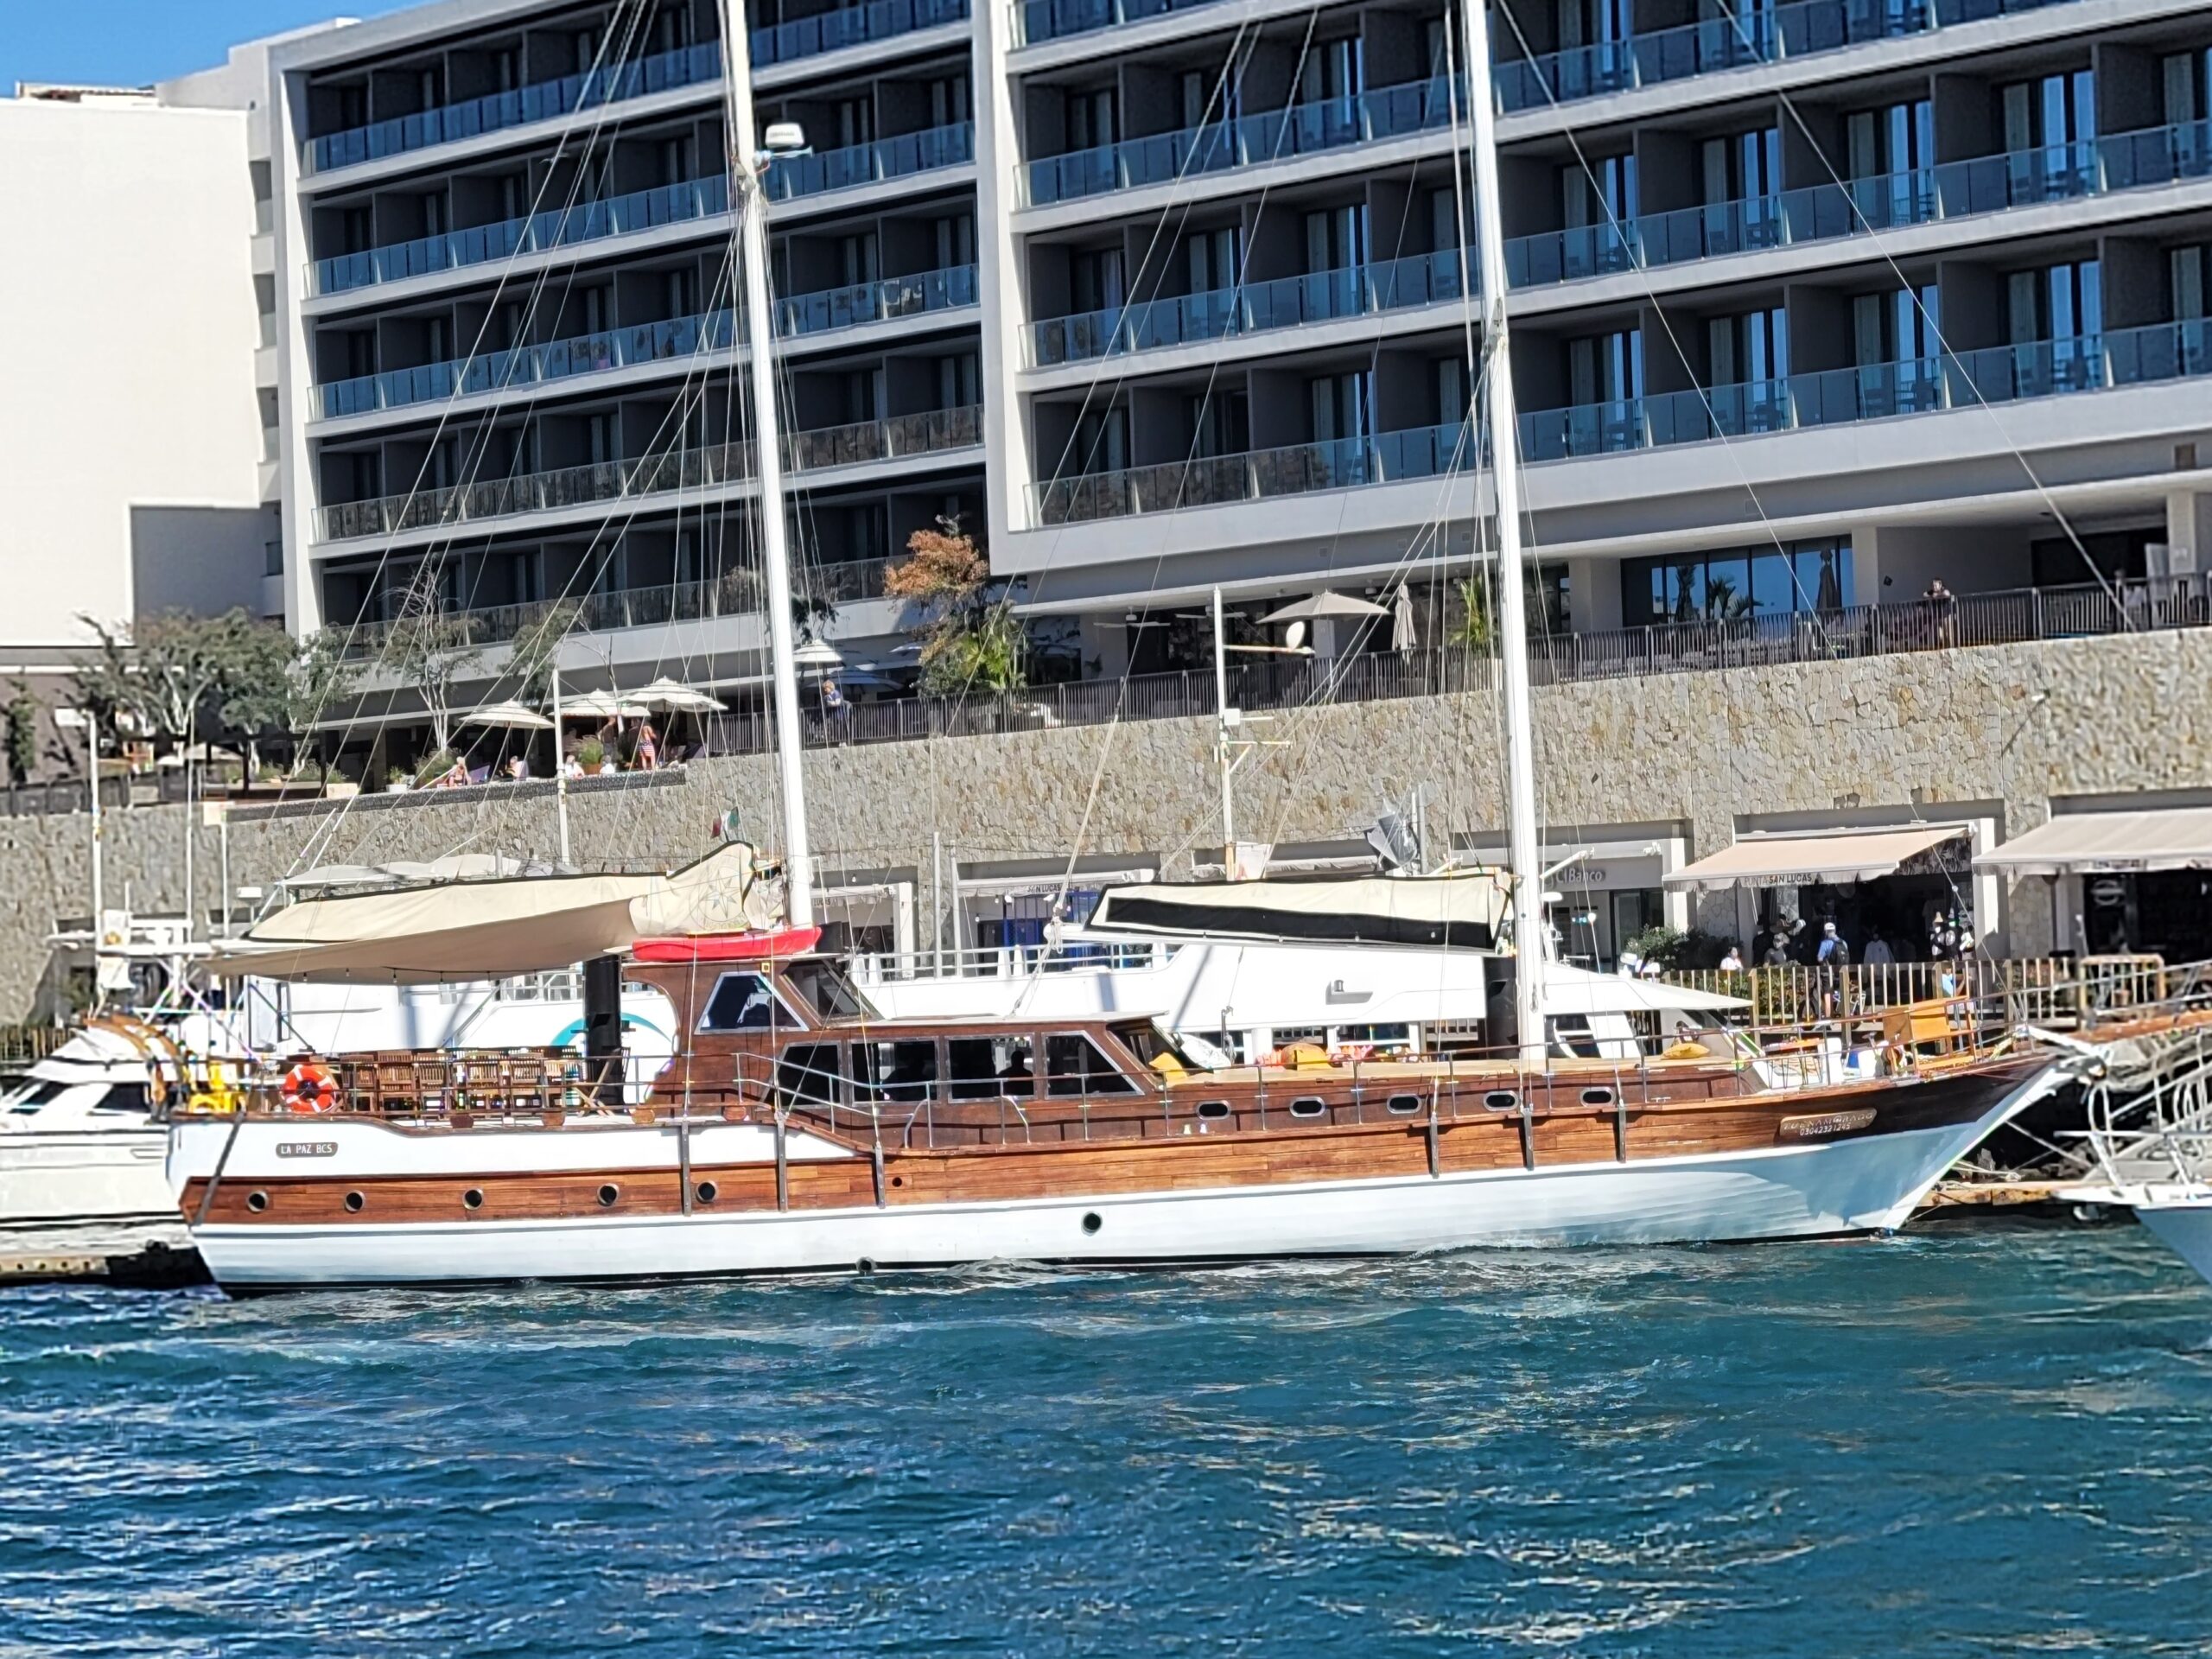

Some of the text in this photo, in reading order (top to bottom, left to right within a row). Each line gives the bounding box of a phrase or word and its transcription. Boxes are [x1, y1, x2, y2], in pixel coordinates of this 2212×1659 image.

[1555, 868, 1603, 884] CIBanco
[1744, 873, 1812, 887] PUNTA SAN LUCAS
[280, 1144, 333, 1154] LA PAZ BCS
